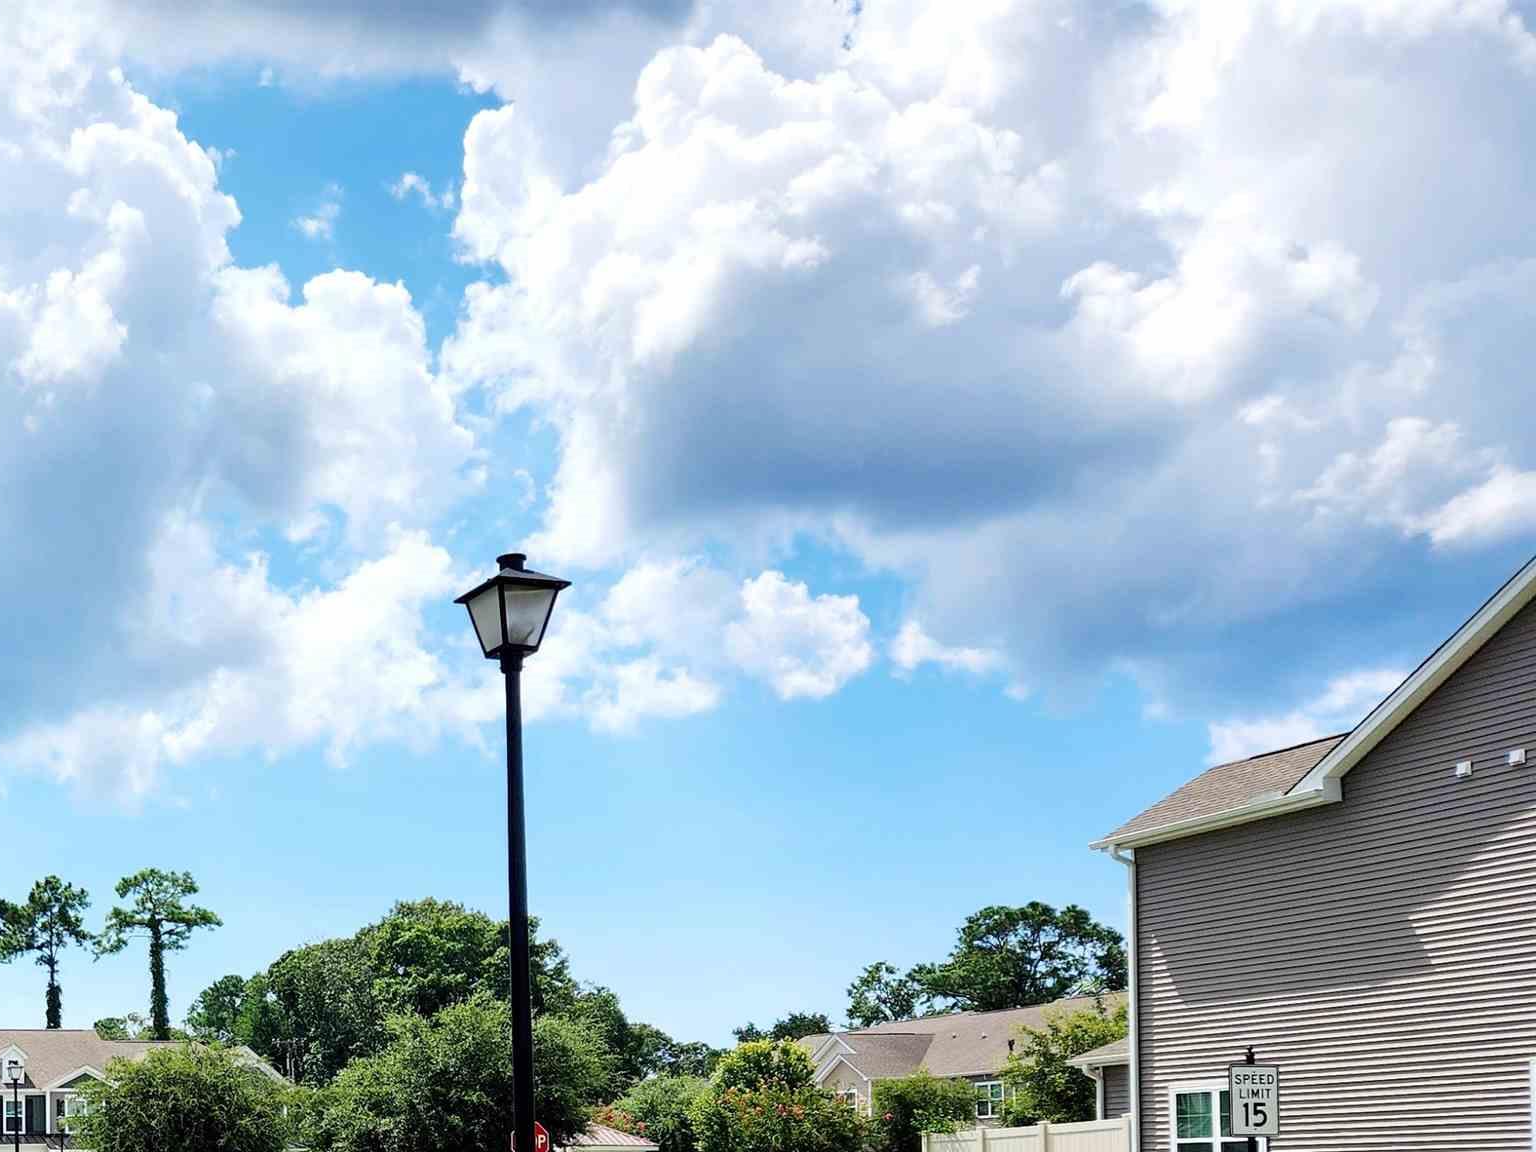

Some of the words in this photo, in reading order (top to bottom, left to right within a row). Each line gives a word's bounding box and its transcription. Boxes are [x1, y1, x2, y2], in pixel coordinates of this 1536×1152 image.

[1234, 1073, 1275, 1085] SPEED
[1239, 1088, 1272, 1099] LIMIT
[1243, 1102, 1267, 1127] 15
